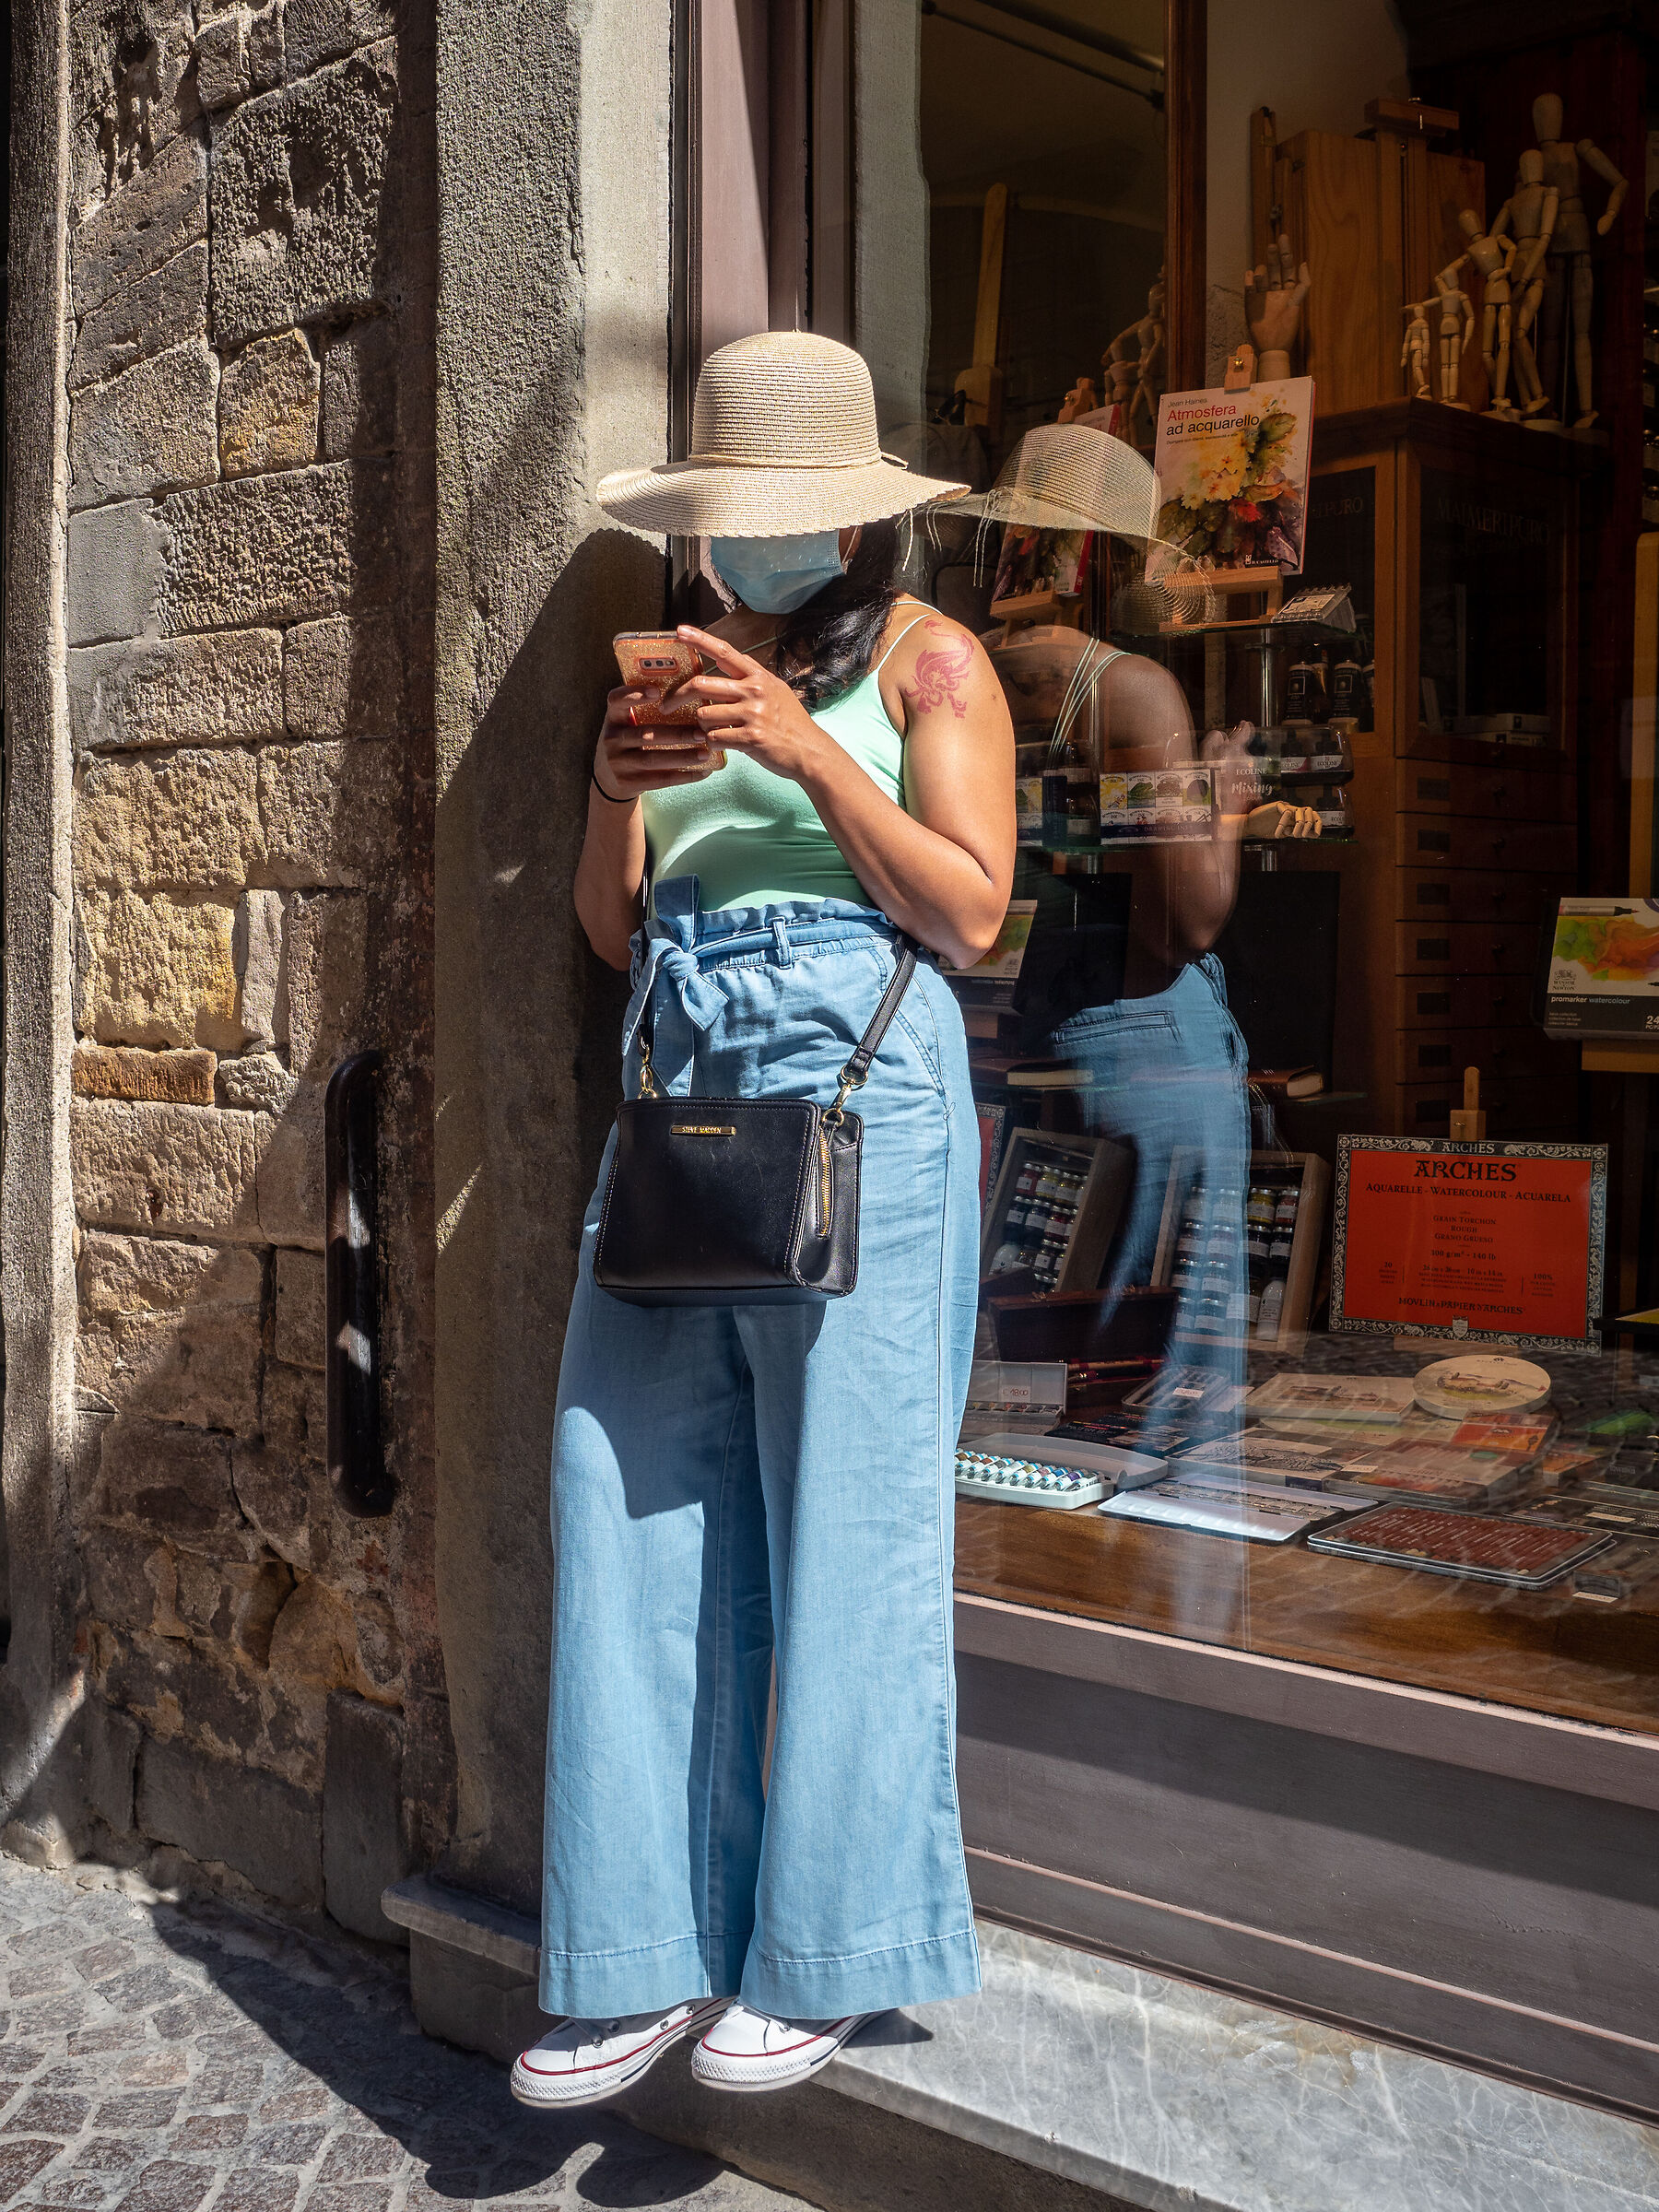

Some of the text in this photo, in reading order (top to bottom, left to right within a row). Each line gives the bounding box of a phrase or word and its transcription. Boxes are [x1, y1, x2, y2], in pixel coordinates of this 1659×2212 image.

[1167, 405, 1237, 422] Atmosfera
[1166, 415, 1260, 436] ad acquarello
[1441, 1142, 1495, 1153] ARCHES
[1414, 1159, 1517, 1182] ARCHES
[1366, 1182, 1423, 1194] AQUARELLE
[1430, 1185, 1508, 1199] WATERCOLOUR
[1514, 1191, 1571, 1203] ACUARELA
[1459, 1216, 1497, 1225] TORCHON
[1451, 1225, 1477, 1233] ROUGH
[1434, 1232, 1494, 1243] GRANO GRUESO
[1473, 1252, 1487, 1260] 140
[1488, 1253, 1497, 1261] lb
